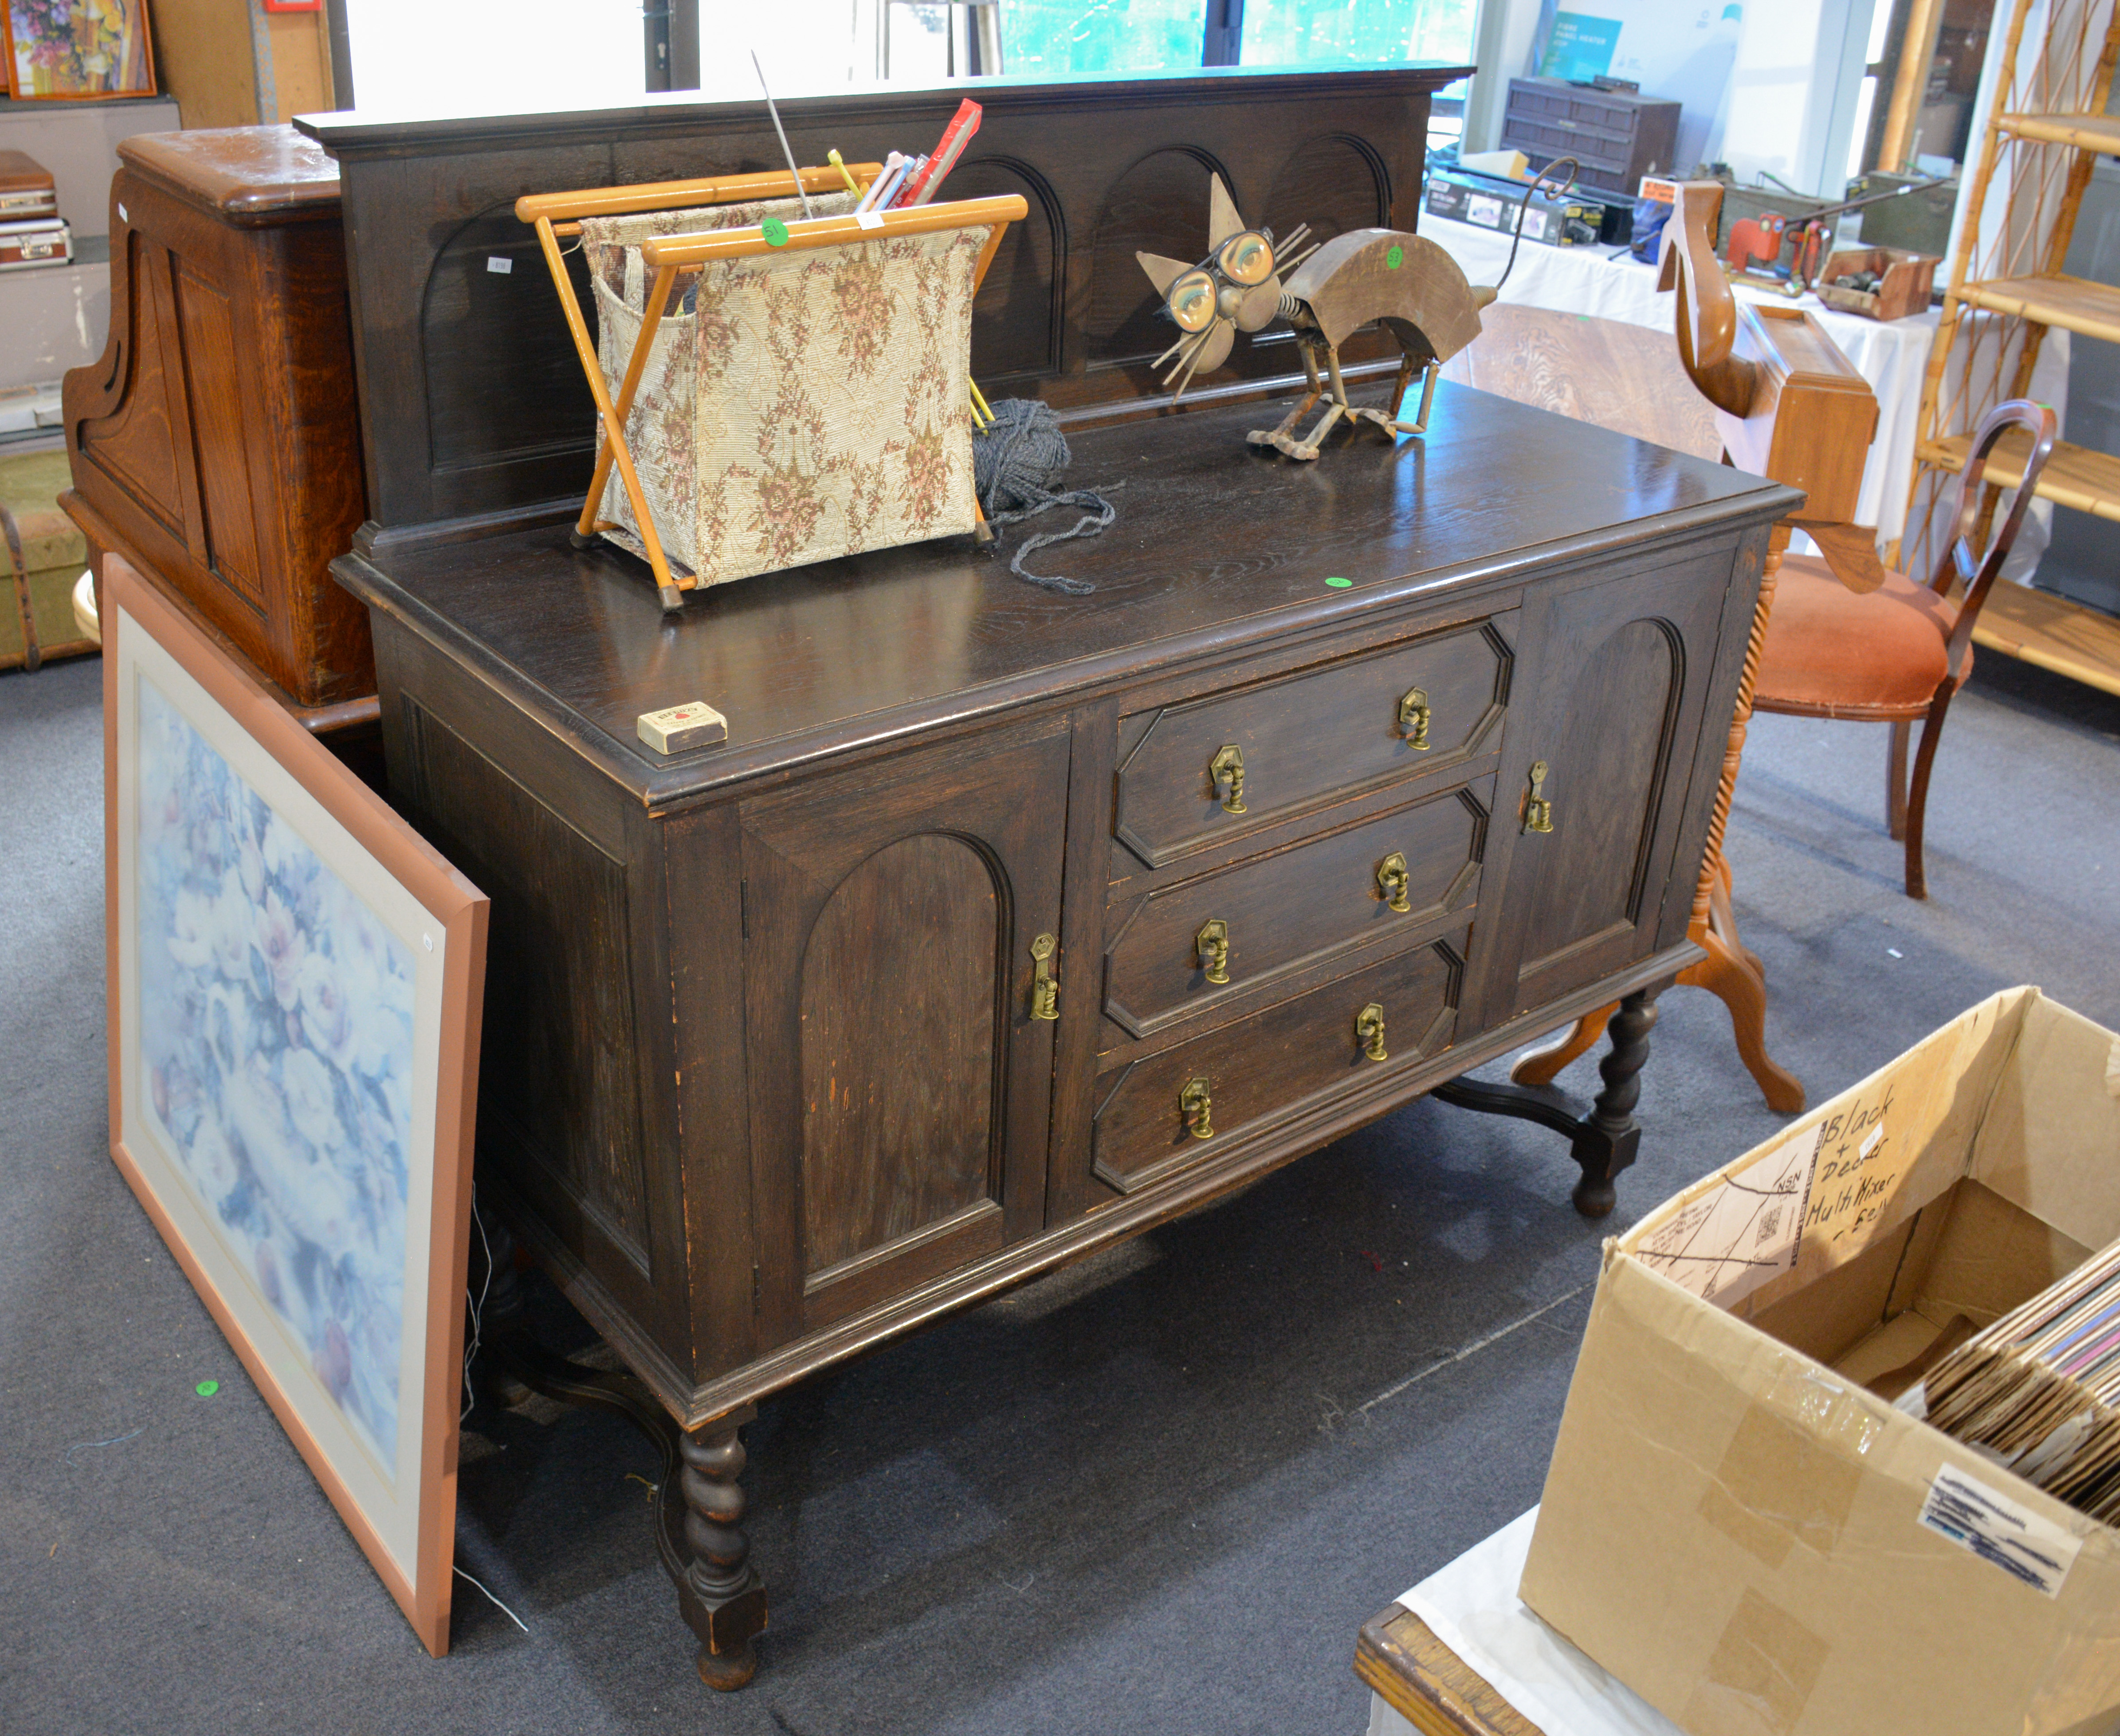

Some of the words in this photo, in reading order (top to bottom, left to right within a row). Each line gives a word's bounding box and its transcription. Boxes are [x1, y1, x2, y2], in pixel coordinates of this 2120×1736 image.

[764, 225, 778, 237] 51
[1389, 251, 1399, 262] 53
[1822, 1084, 1894, 1148] Black
[1777, 1169, 1802, 1193] NSN
